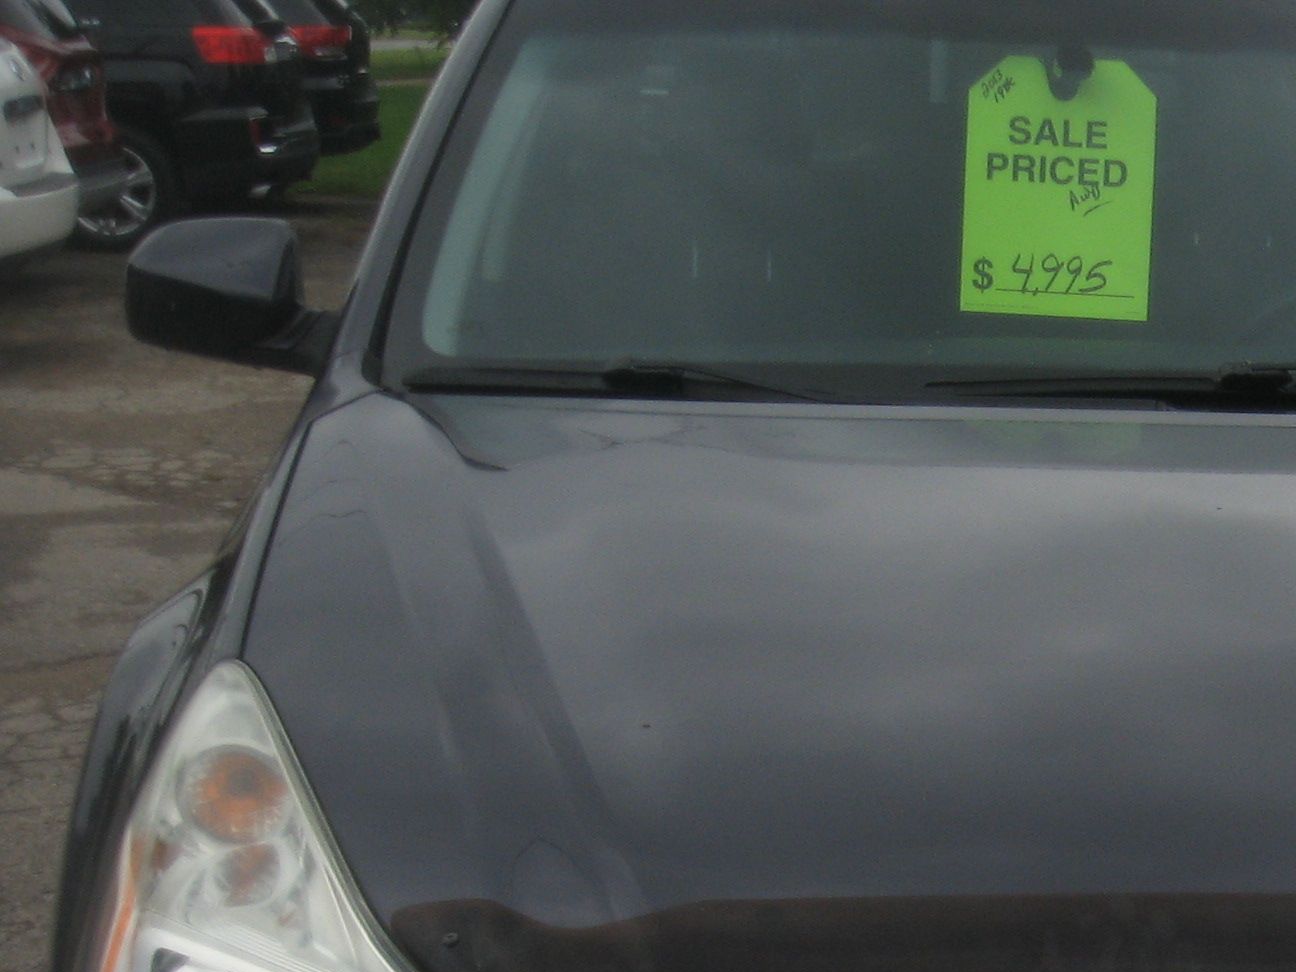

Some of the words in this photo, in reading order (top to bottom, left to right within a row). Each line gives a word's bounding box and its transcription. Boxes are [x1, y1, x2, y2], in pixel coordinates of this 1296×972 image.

[1008, 115, 1108, 149] SALE
[986, 152, 1128, 188] PRICED
[972, 256, 994, 293] $
